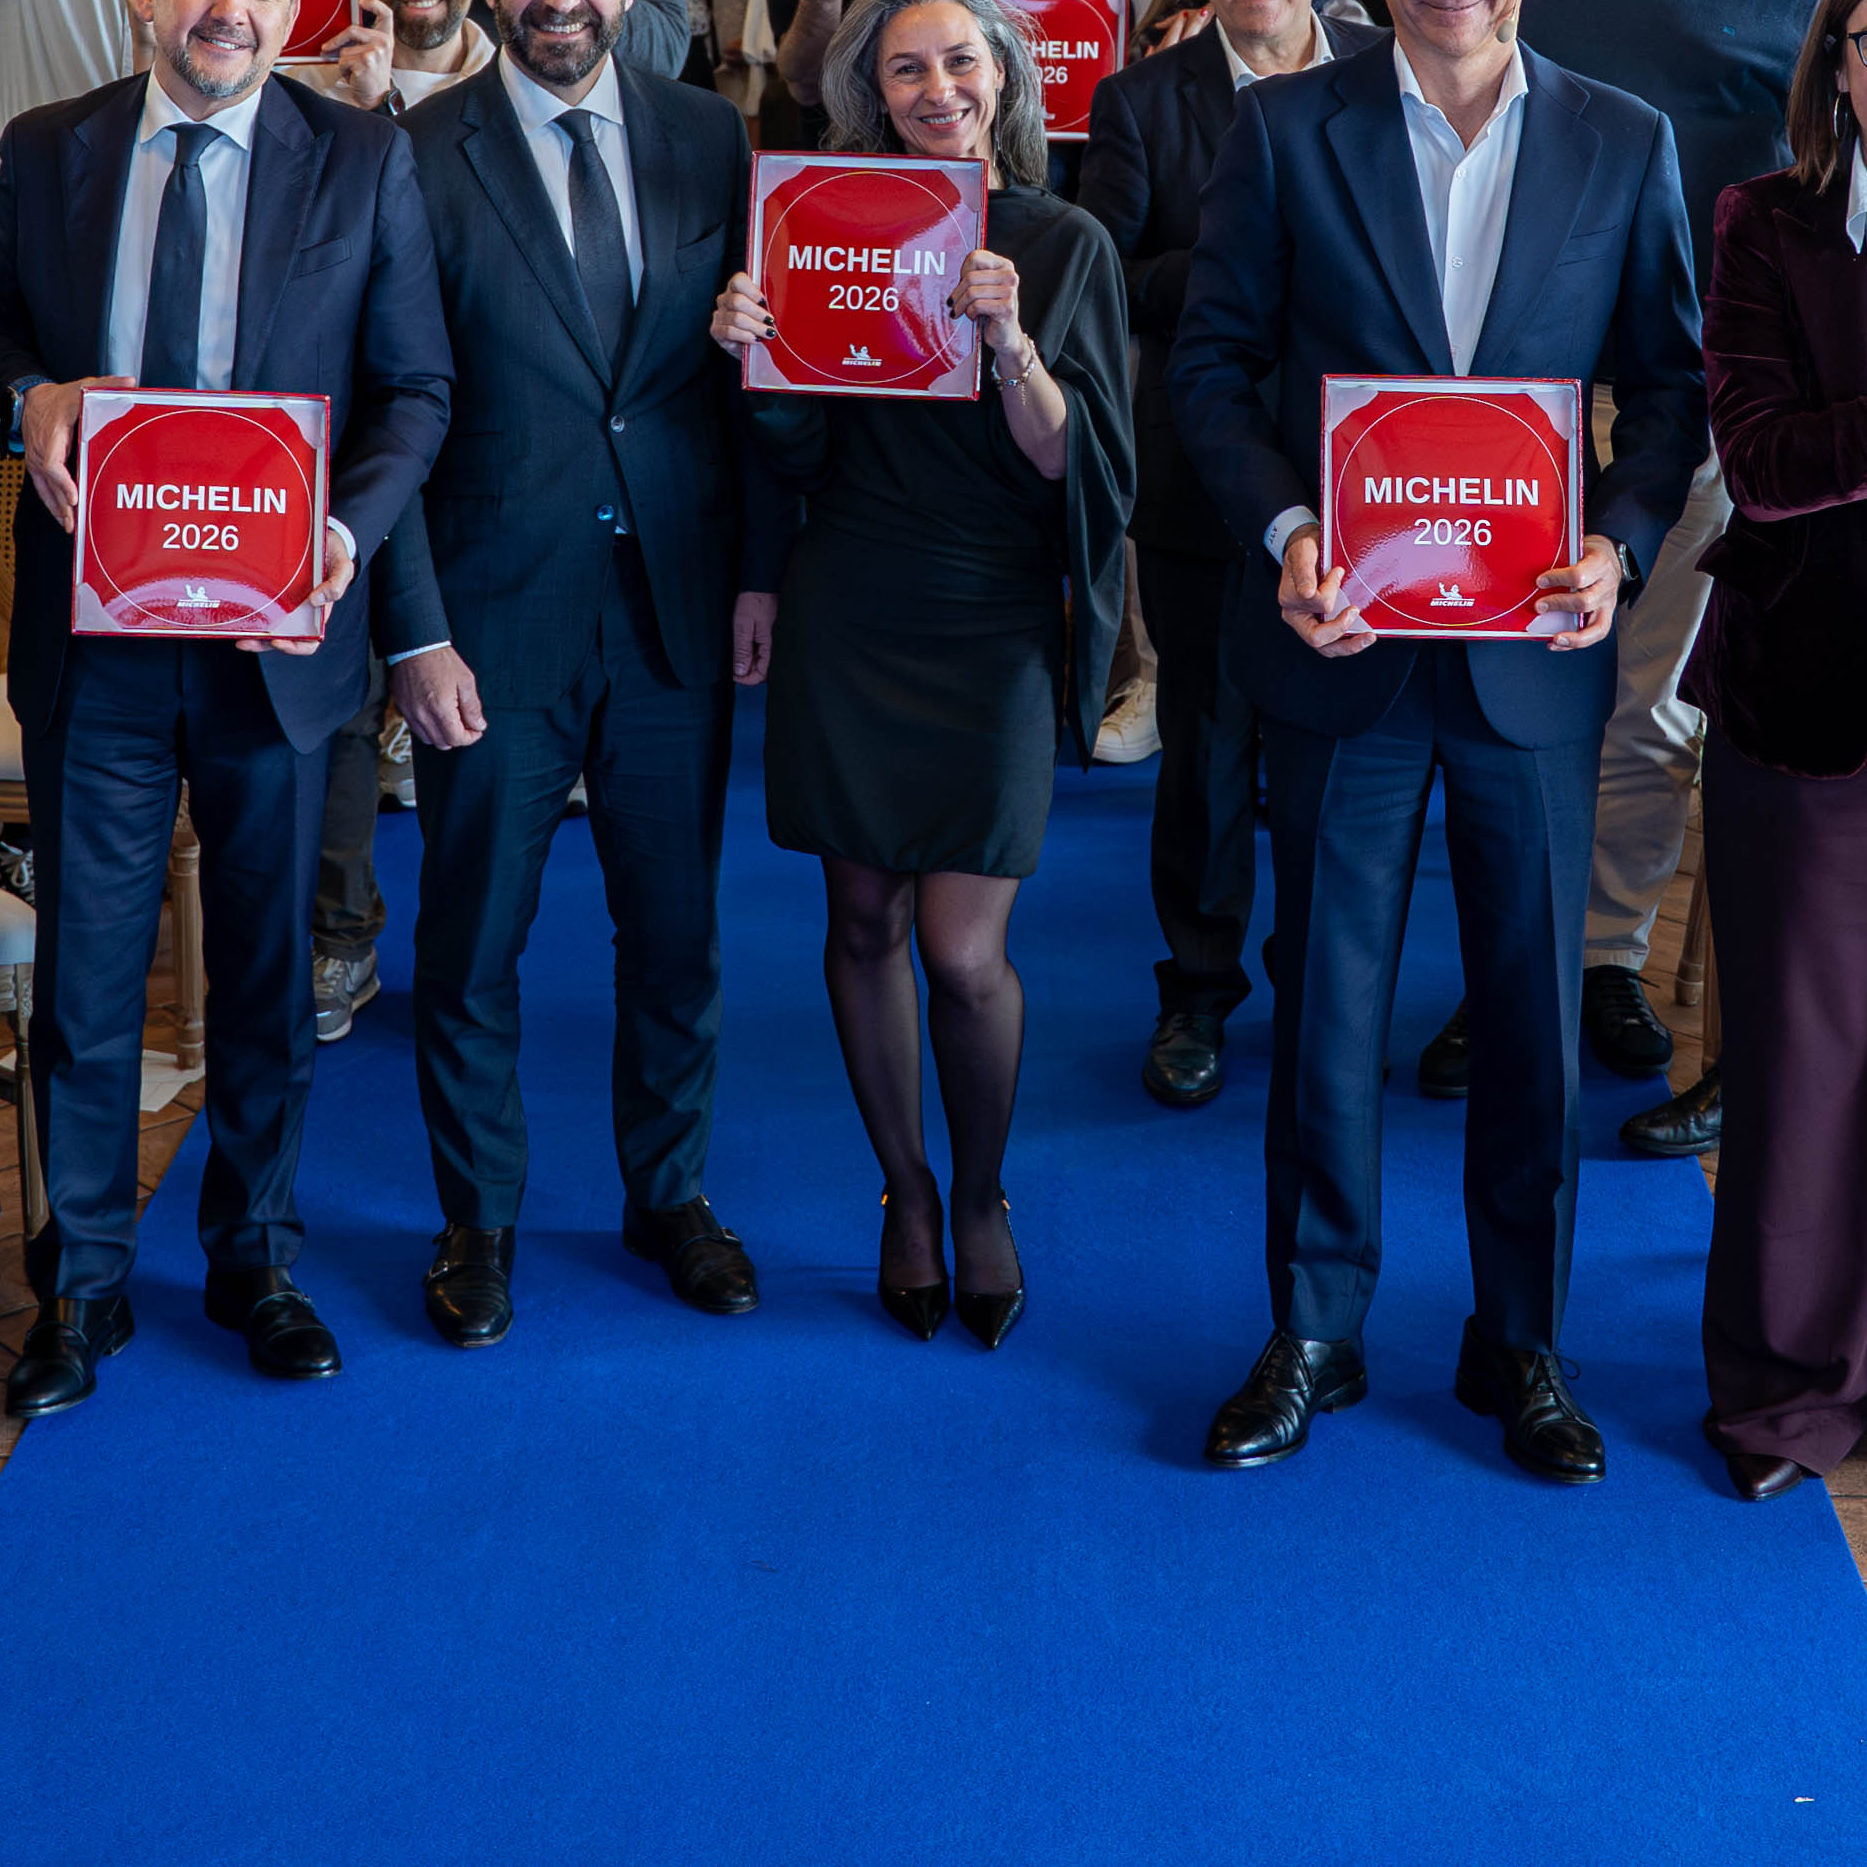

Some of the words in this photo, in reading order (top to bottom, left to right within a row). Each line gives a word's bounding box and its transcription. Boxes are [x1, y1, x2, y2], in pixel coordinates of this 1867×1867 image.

[1031, 40, 1099, 59] HELIN
[788, 245, 946, 276] MICHELIN
[828, 285, 899, 312] 2026
[116, 483, 287, 515] MICHELIN
[1364, 476, 1539, 506] MICHELIN
[162, 523, 239, 551] 2026
[1413, 518, 1492, 546] 2026
[1430, 599, 1474, 607] MICHELIN
